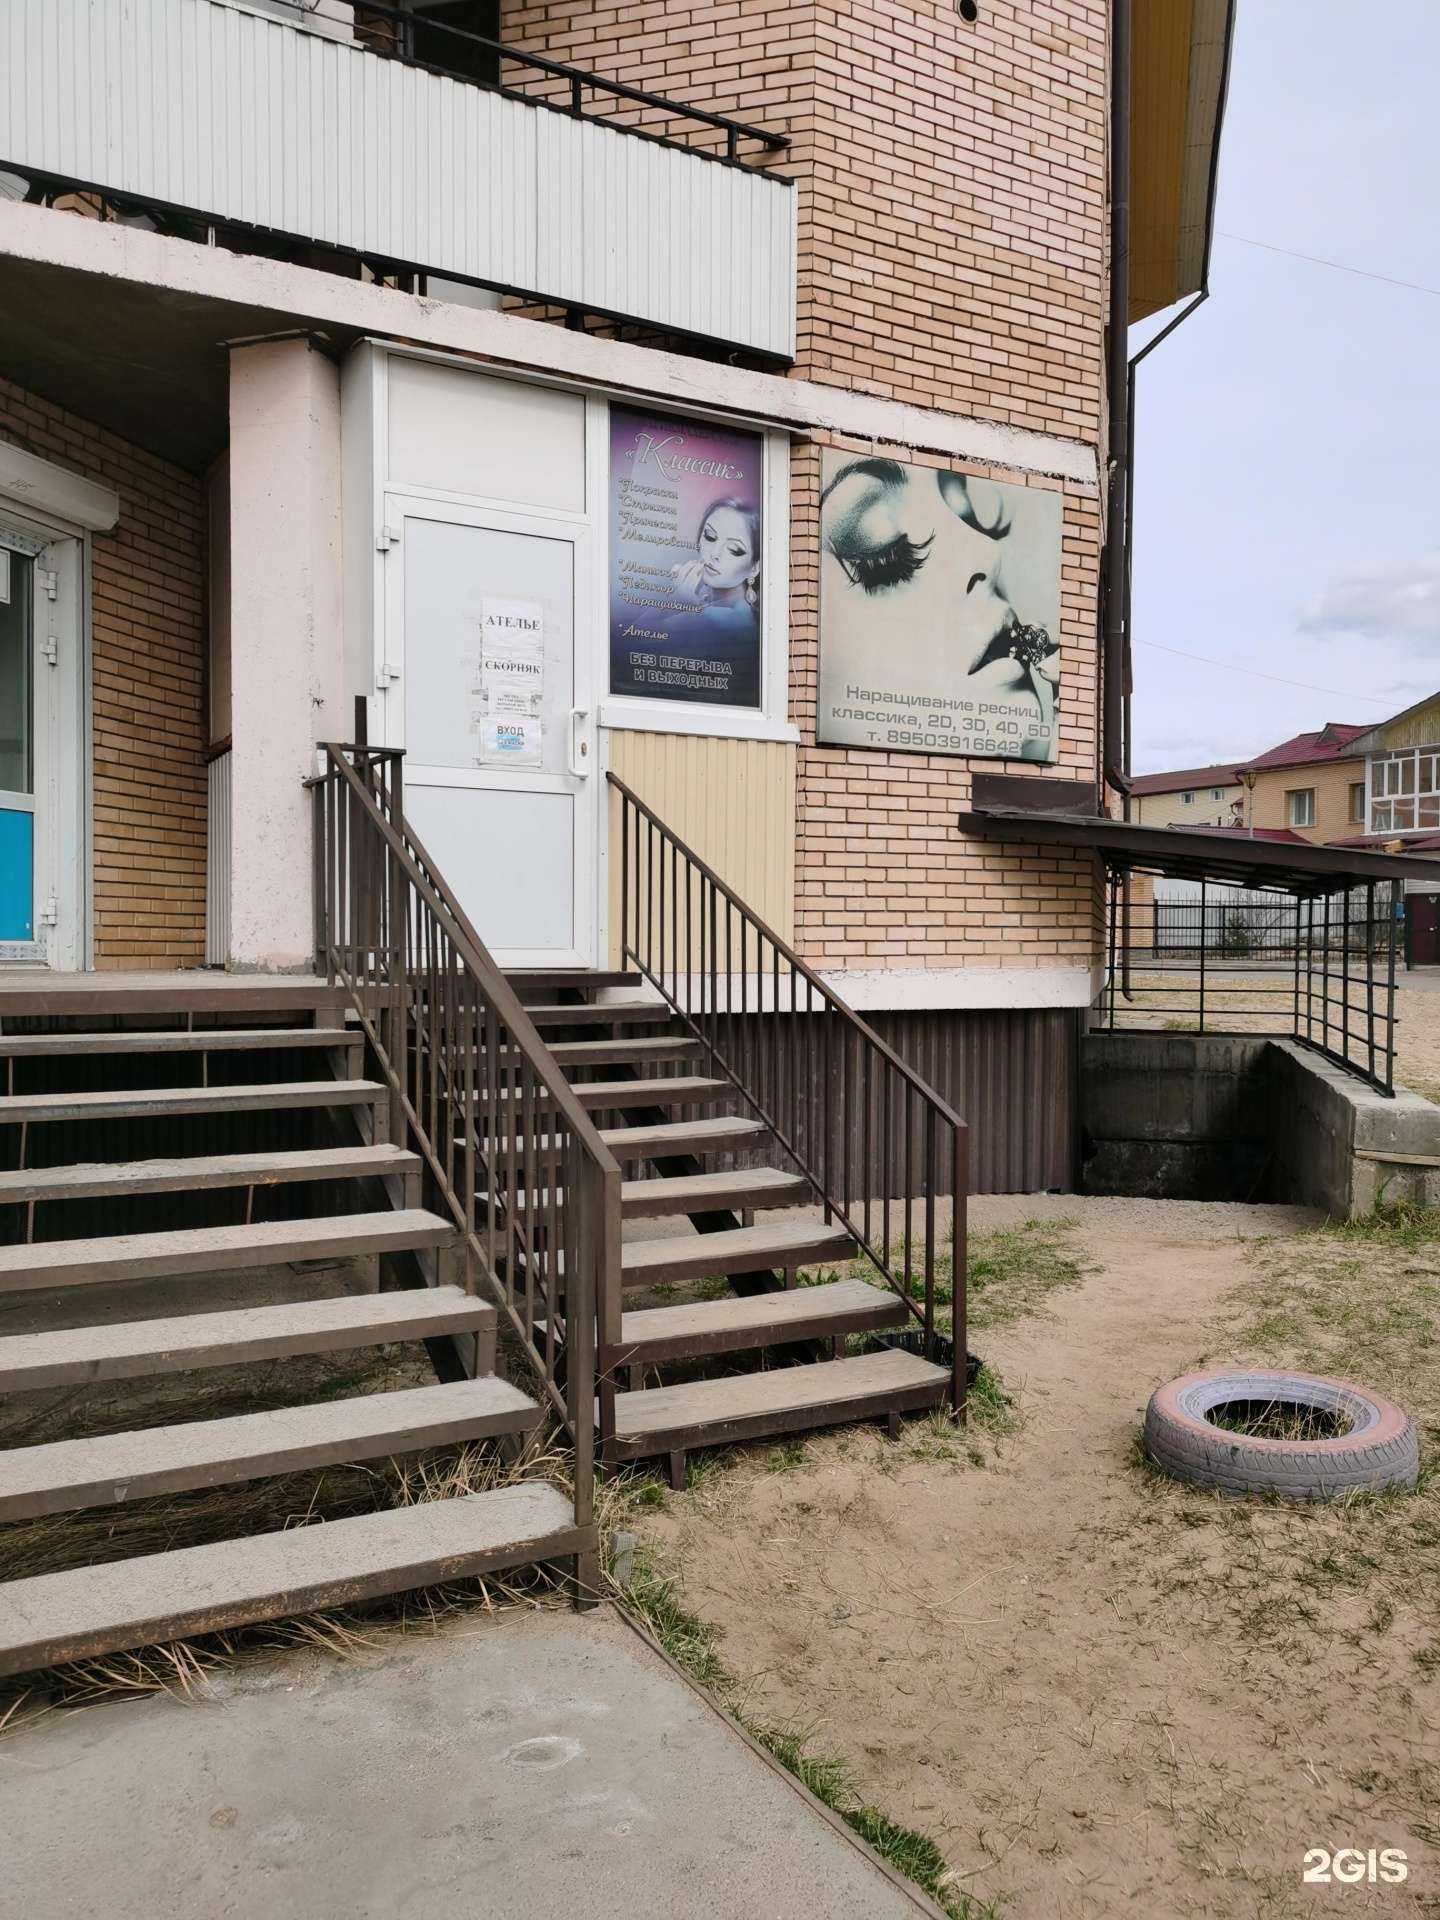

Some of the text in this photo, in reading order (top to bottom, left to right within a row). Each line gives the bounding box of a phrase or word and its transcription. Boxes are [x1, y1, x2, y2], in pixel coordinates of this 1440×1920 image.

[486, 615, 541, 631] АТЕЛЬЕ
[622, 624, 669, 640] Ателье
[485, 660, 541, 675] СКОРНЯК
[630, 652, 733, 675] БЕЗ ПЕРЕРЫВА
[634, 668, 729, 690] И ВЫХОДНЫХ
[846, 684, 1039, 721] Наращивание ресниц
[497, 725, 525, 737] ВХОД
[832, 706, 1051, 739] классика, 2D, 3D, 4D, 5D
[867, 730, 1020, 754] т. 89503916642
